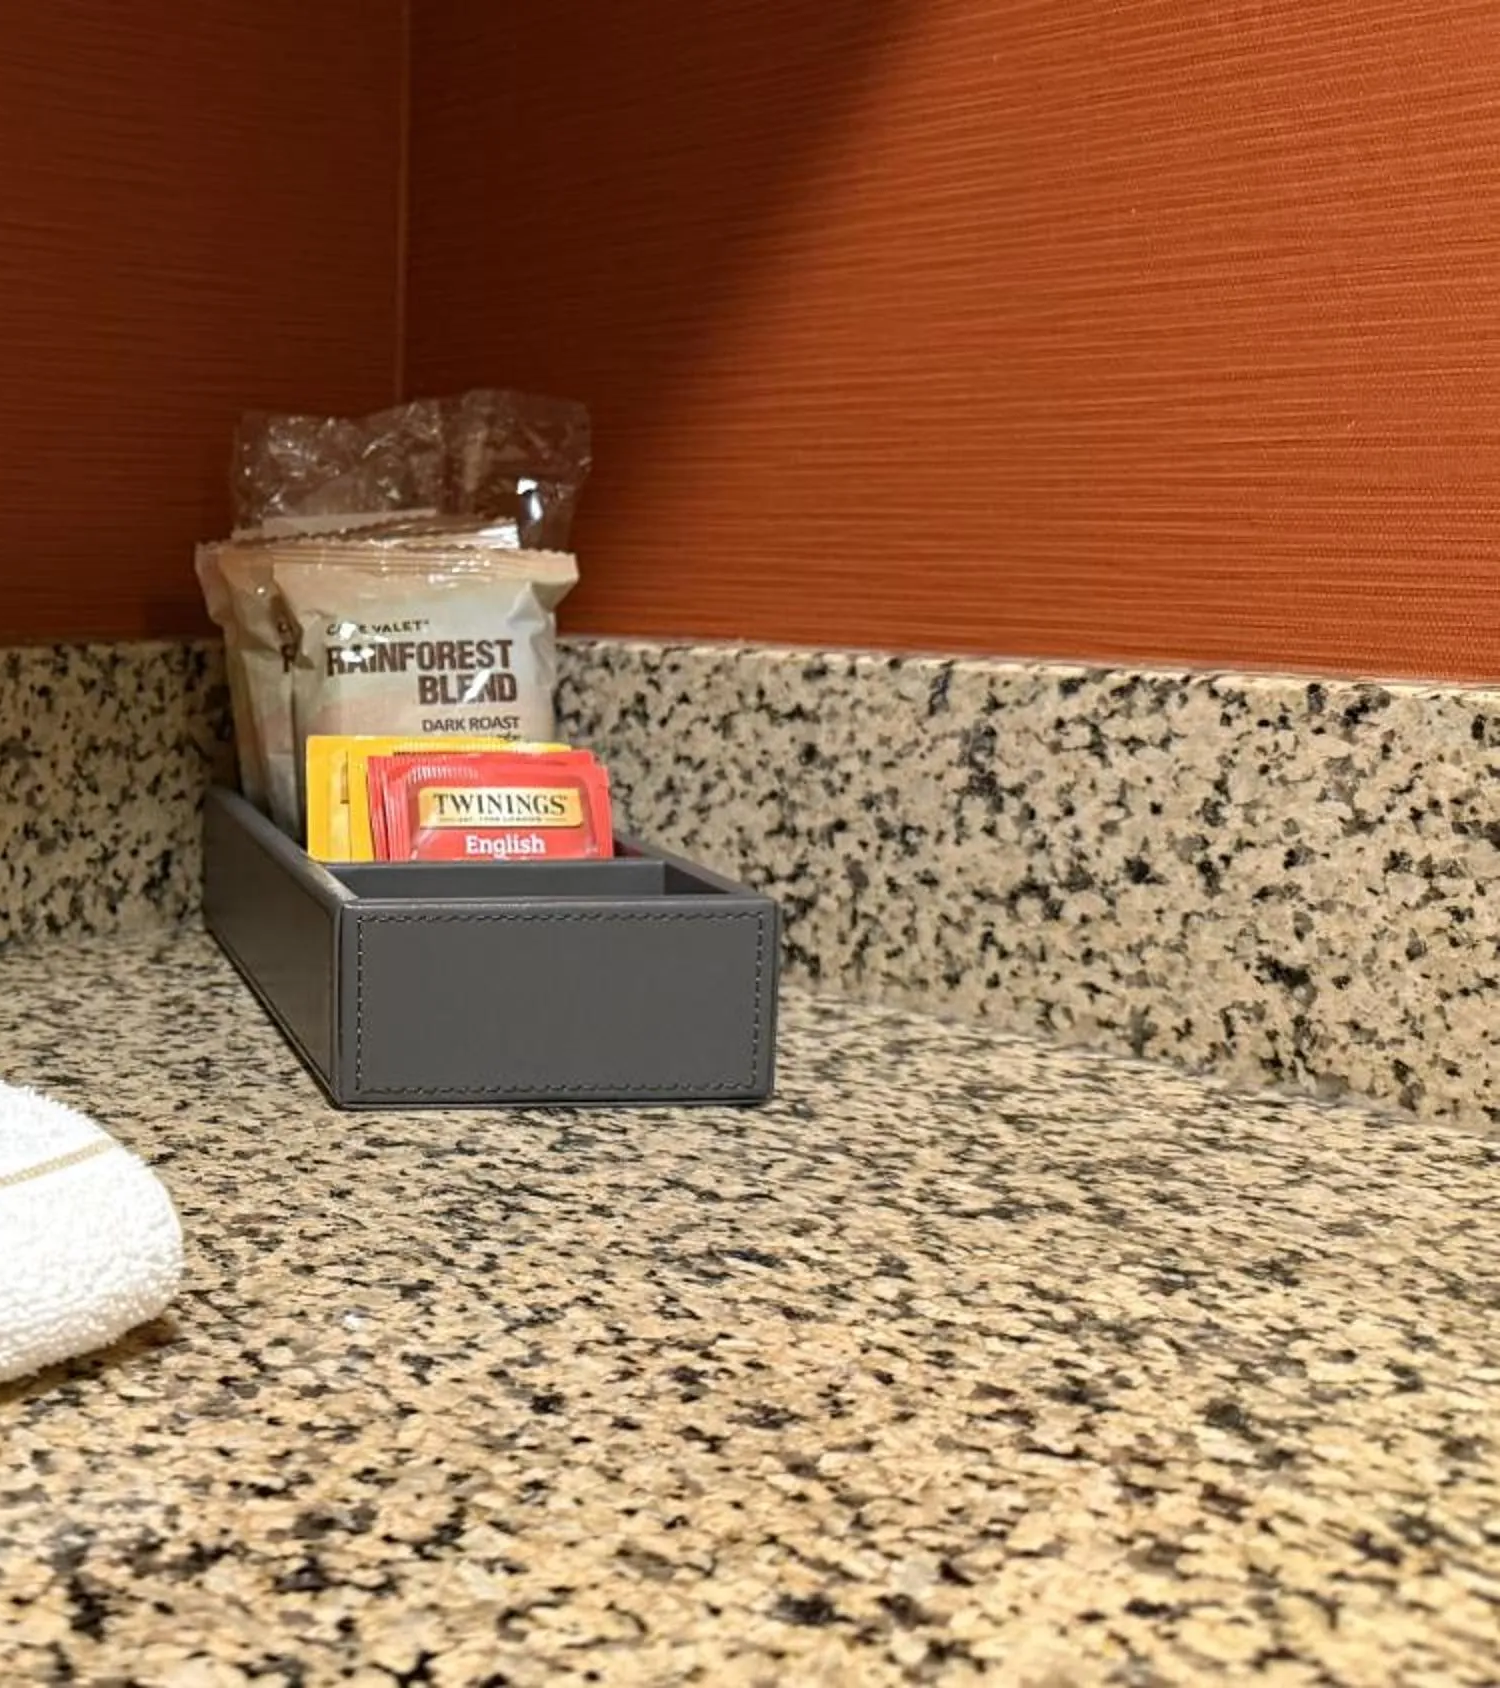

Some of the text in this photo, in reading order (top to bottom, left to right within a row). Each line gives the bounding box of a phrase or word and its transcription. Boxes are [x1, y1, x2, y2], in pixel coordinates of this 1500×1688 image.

[326, 623, 367, 636] CE
[326, 640, 513, 677] RAINFOREST
[418, 673, 518, 705] BLEND
[422, 716, 520, 732] DARK ROAST
[433, 792, 567, 815] TWININGS
[465, 834, 546, 859] English
